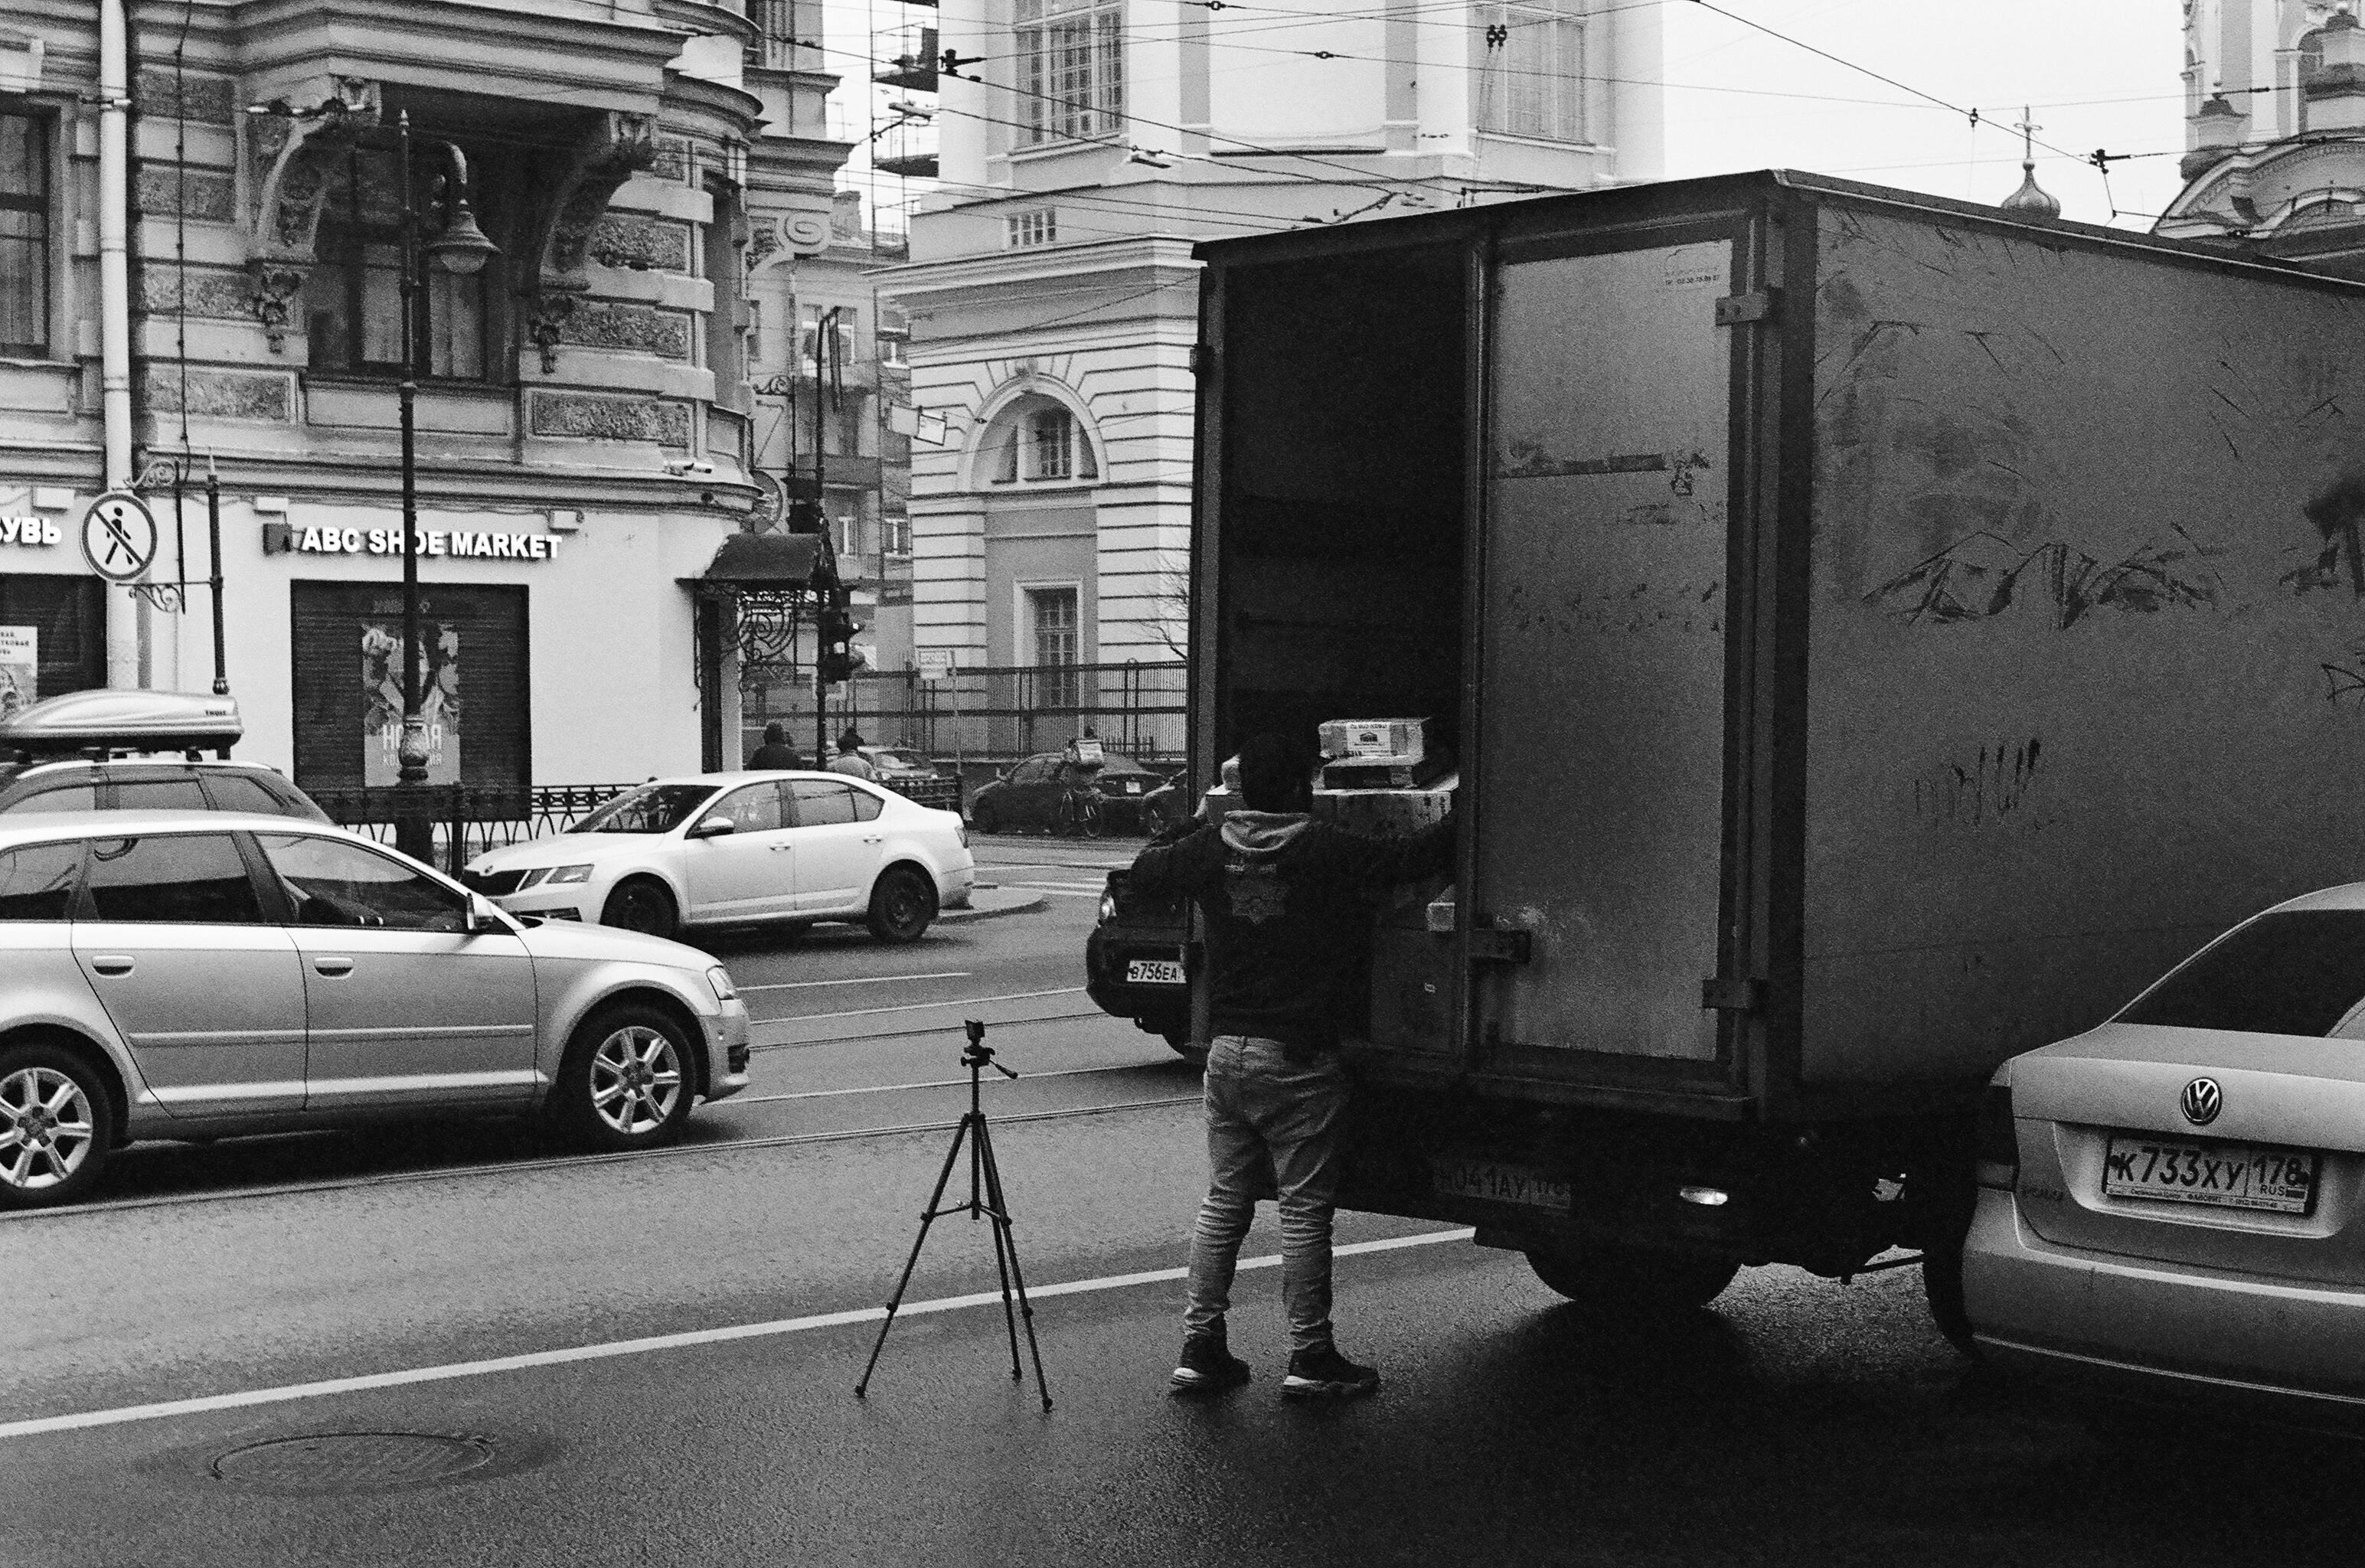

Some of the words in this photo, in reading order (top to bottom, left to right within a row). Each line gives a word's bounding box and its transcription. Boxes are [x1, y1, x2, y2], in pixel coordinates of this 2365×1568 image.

[0, 515, 62, 544] УВЬ
[302, 526, 361, 553] ABC
[451, 531, 563, 558] MARKET
[2260, 1184, 2285, 1197] RUS
